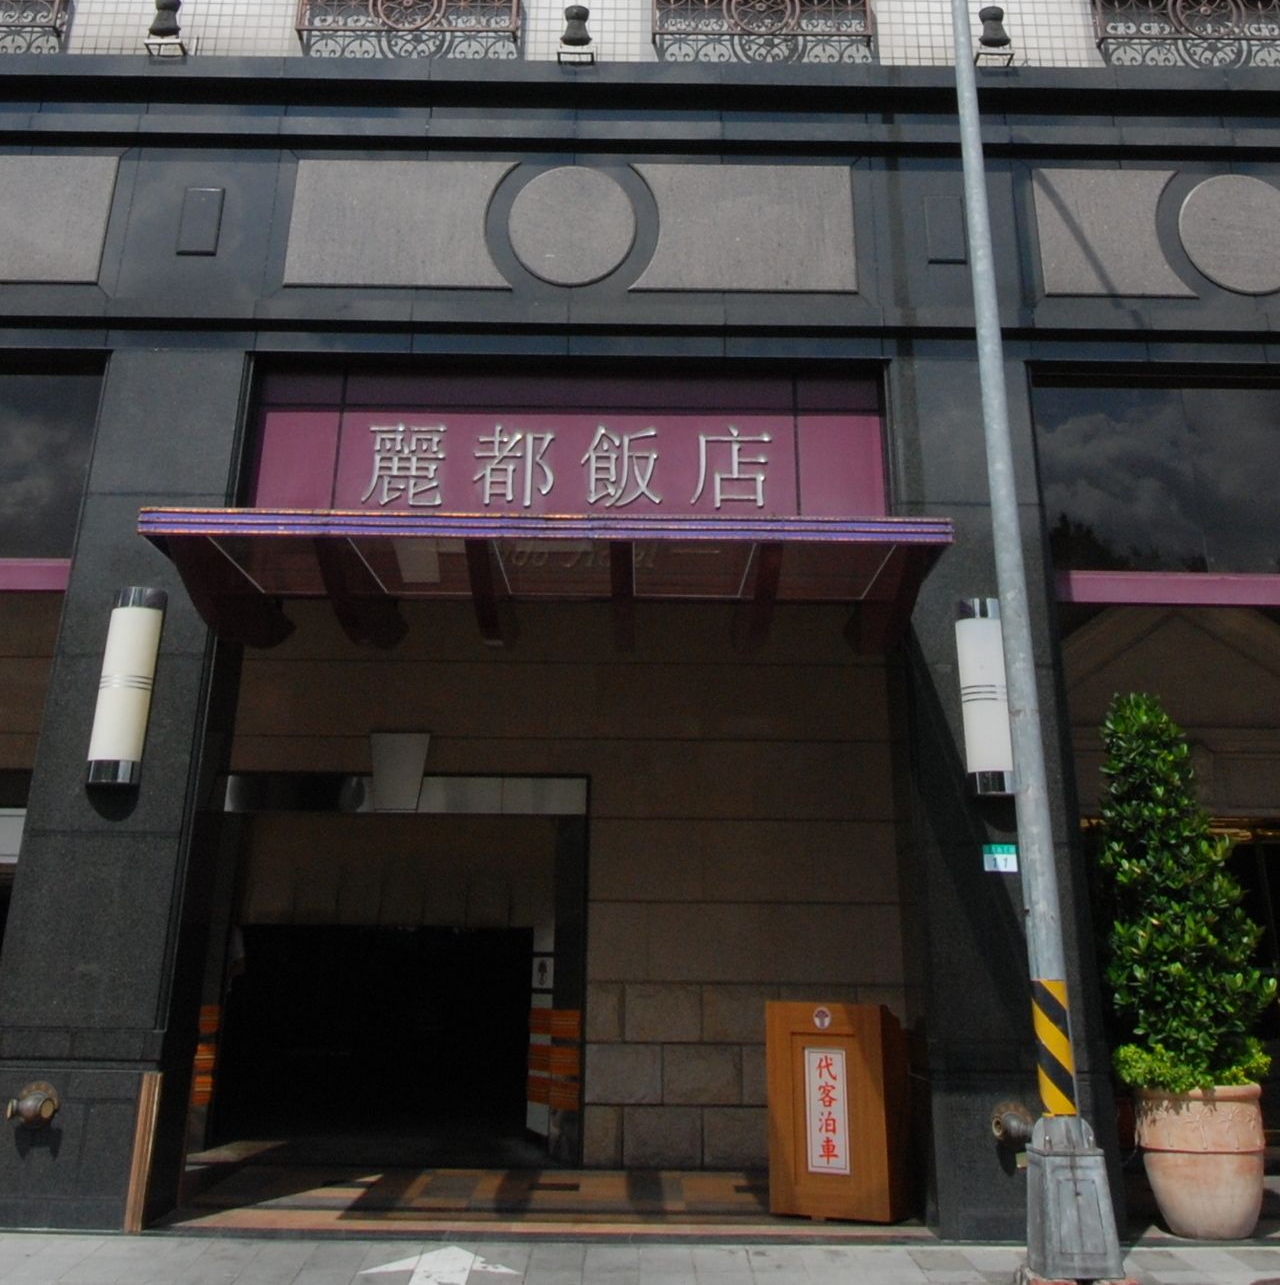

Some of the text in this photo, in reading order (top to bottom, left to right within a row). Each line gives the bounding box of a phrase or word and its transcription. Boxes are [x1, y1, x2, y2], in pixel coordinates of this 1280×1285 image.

[361, 422, 773, 509] 麗都飯店
[816, 1055, 839, 1166] 代客泊車
